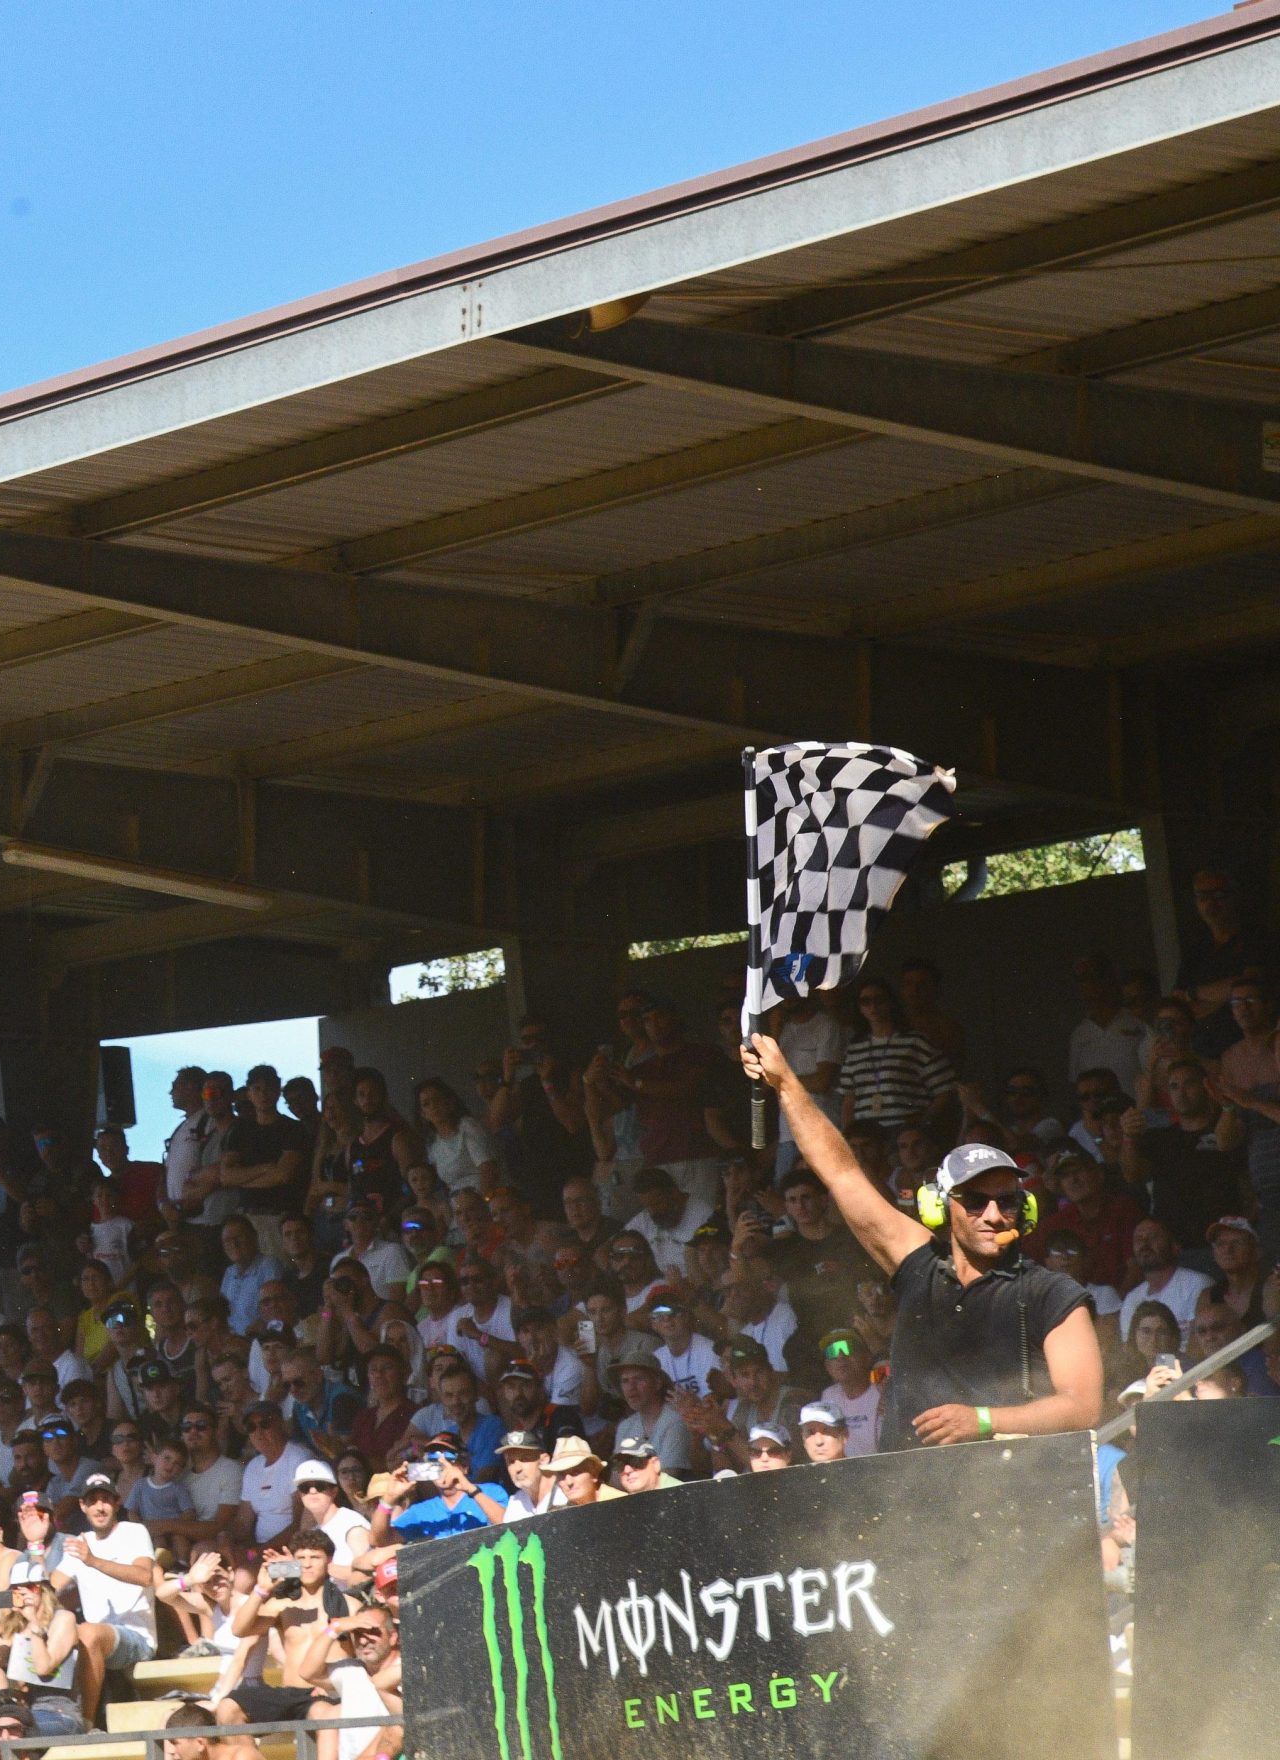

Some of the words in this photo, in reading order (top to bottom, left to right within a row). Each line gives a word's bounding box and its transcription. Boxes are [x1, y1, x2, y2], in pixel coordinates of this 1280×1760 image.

[964, 1148, 998, 1163] FIM
[573, 1561, 895, 1680] MONSTER
[624, 1671, 839, 1729] ENERGY
